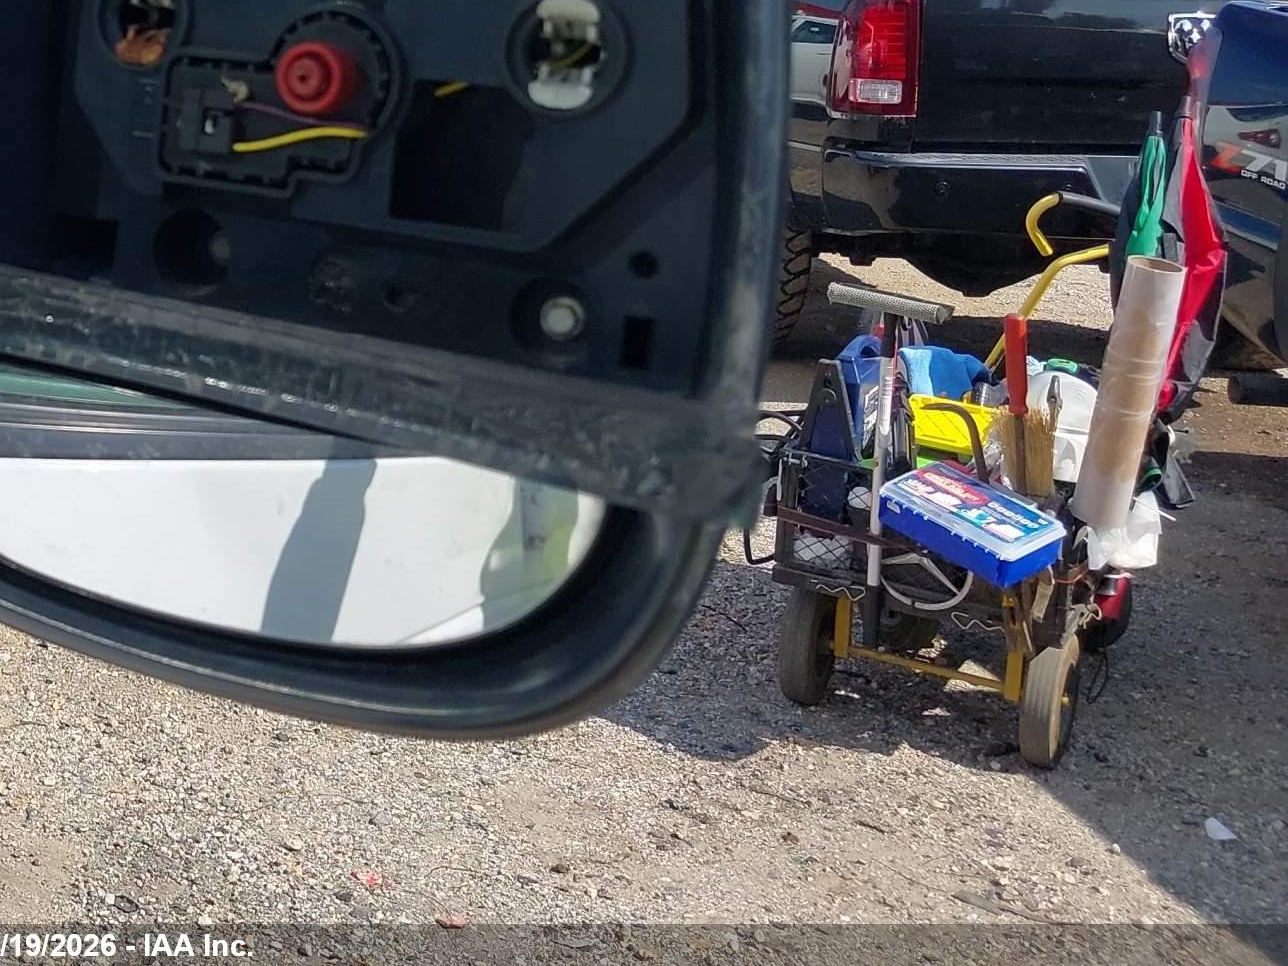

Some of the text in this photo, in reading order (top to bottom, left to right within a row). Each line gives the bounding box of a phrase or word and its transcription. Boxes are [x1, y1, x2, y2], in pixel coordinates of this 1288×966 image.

[1210, 140, 1288, 181] Z71
[1240, 169, 1287, 190] OFF ROAD
